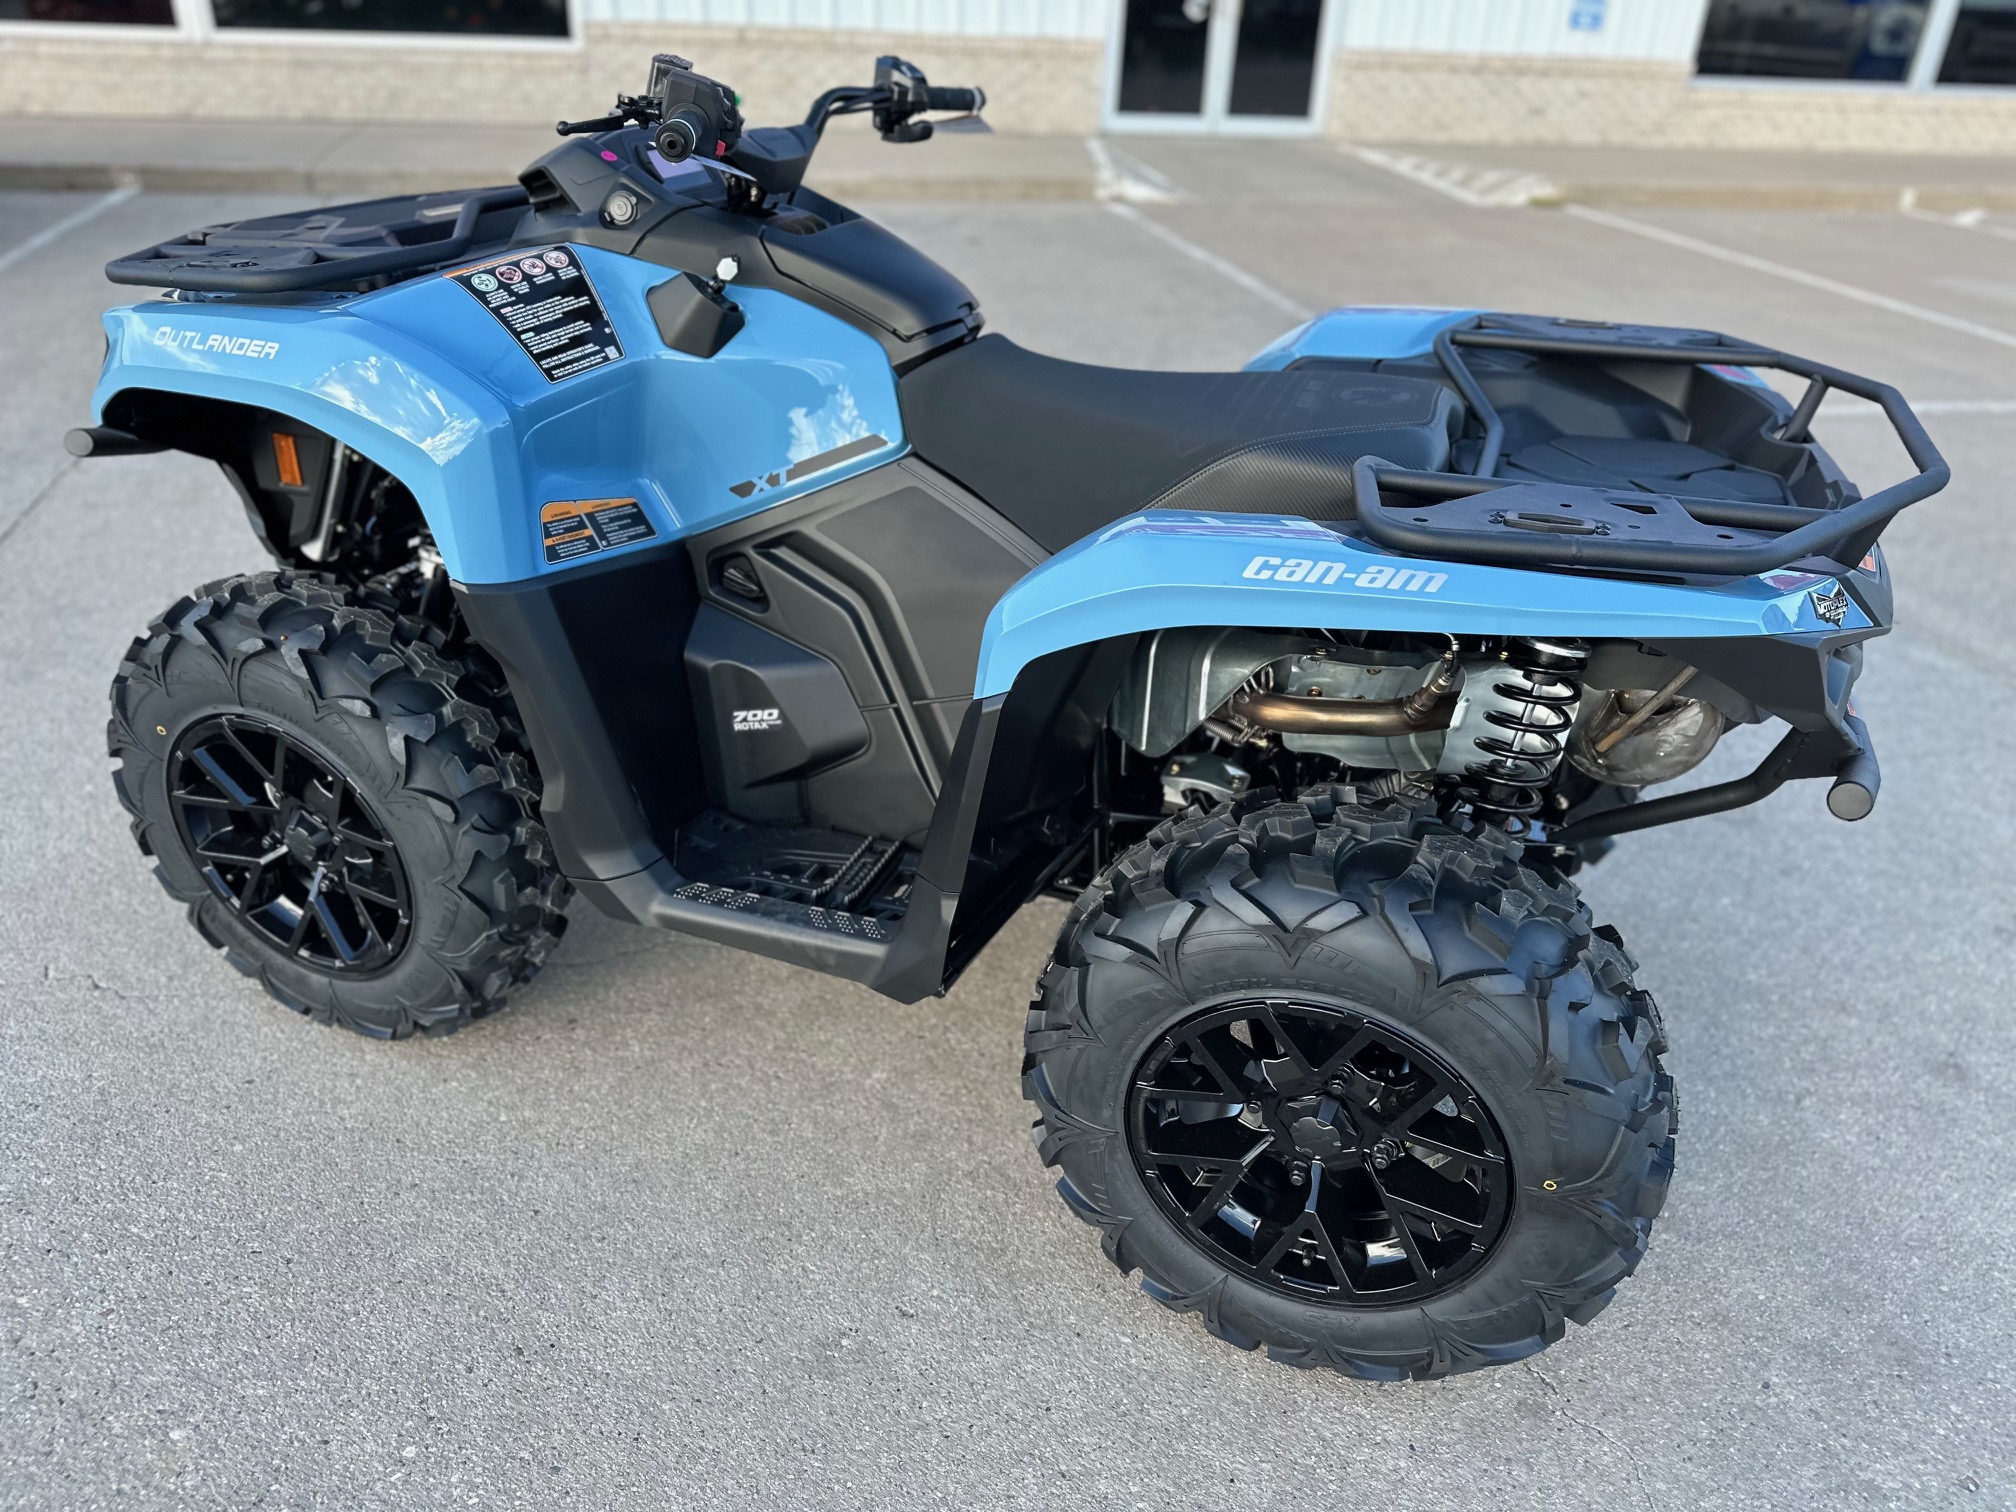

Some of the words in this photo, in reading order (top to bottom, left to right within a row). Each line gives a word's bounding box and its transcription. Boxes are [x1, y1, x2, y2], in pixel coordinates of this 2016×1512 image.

[153, 326, 280, 360] OUTLANDER
[750, 464, 794, 496] XT
[1242, 556, 1449, 593] can-am
[733, 709, 779, 722] 700
[733, 721, 769, 731] ROTAX
